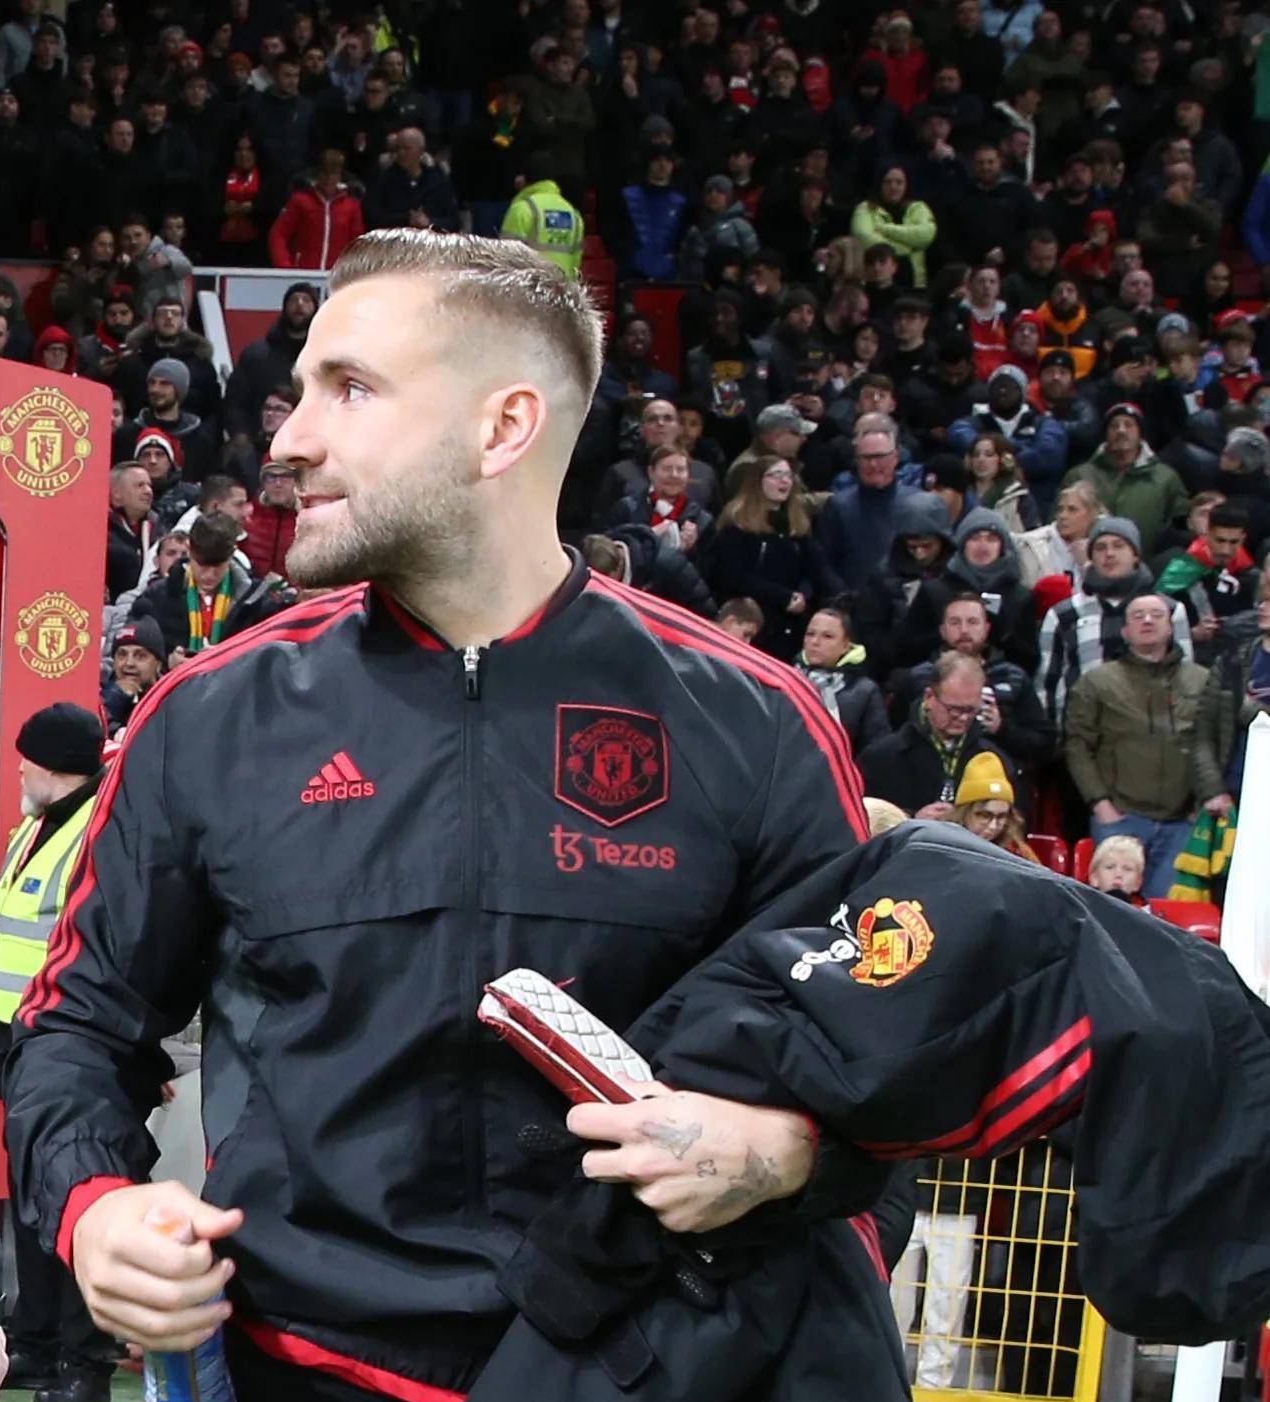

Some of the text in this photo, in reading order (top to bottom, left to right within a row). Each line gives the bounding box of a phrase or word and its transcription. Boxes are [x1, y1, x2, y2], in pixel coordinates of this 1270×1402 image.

[6, 395, 83, 432] MANCHESTER
[17, 469, 70, 489] UNITED
[23, 598, 84, 627] MANCHESTER
[30, 657, 73, 672] UNITED
[300, 780, 375, 803] adidas
[589, 836, 676, 870] Tezos
[696, 1158, 717, 1178] 23
